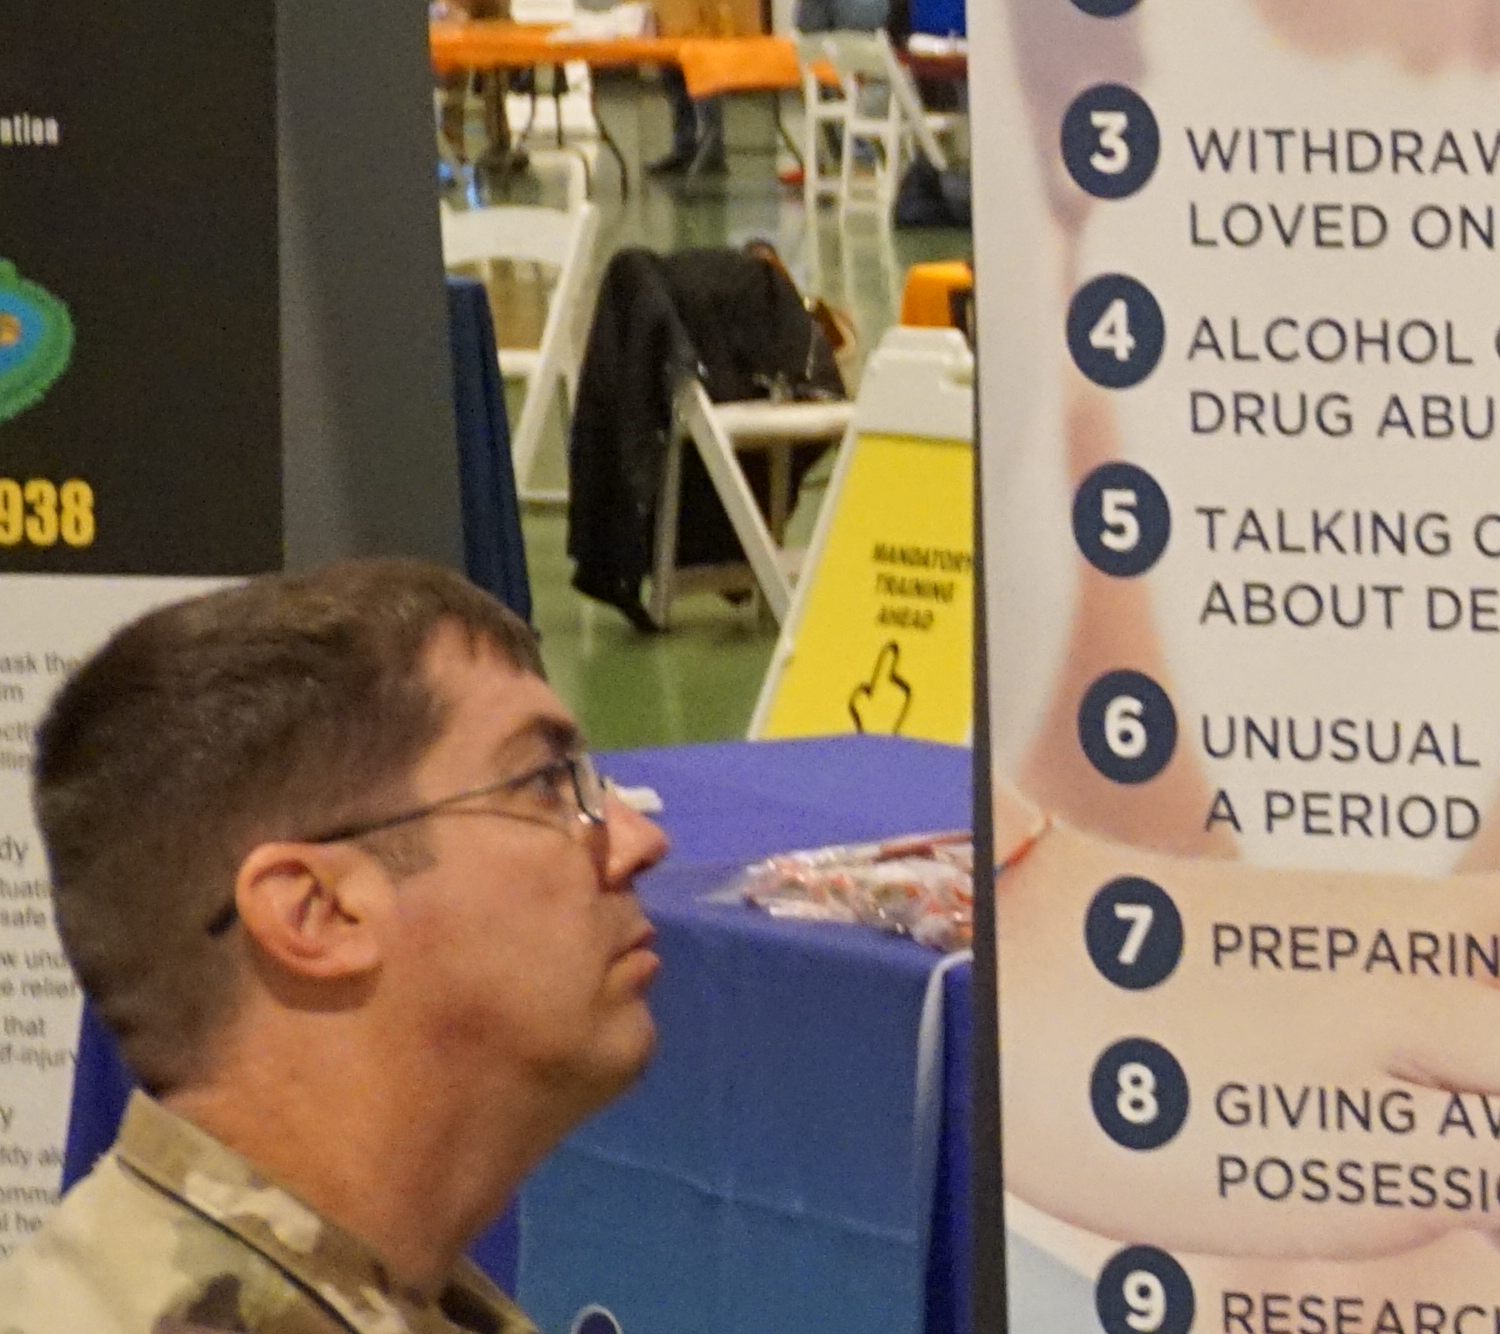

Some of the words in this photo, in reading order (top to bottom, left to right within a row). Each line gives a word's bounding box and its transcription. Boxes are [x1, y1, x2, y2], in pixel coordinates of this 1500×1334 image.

[1090, 111, 1130, 175] 3
[1188, 201, 1390, 250] LOVED
[1088, 298, 1136, 362] 4
[1186, 315, 1474, 366] ALCOHOL
[1189, 389, 1354, 439] DRUG
[1100, 488, 1140, 552] 5
[1194, 505, 1452, 558] TALKING
[1199, 580, 1405, 630] ABOUT
[1104, 695, 1147, 759] 6
[1201, 714, 1482, 769] UNUSUAL
[1203, 788, 1243, 834] A
[1264, 789, 1482, 842] PERIOD
[1114, 903, 1154, 965] 7
[1116, 1062, 1159, 1124] 8
[1213, 1081, 1417, 1136] GIVING
[1122, 1270, 1167, 1333] 9
